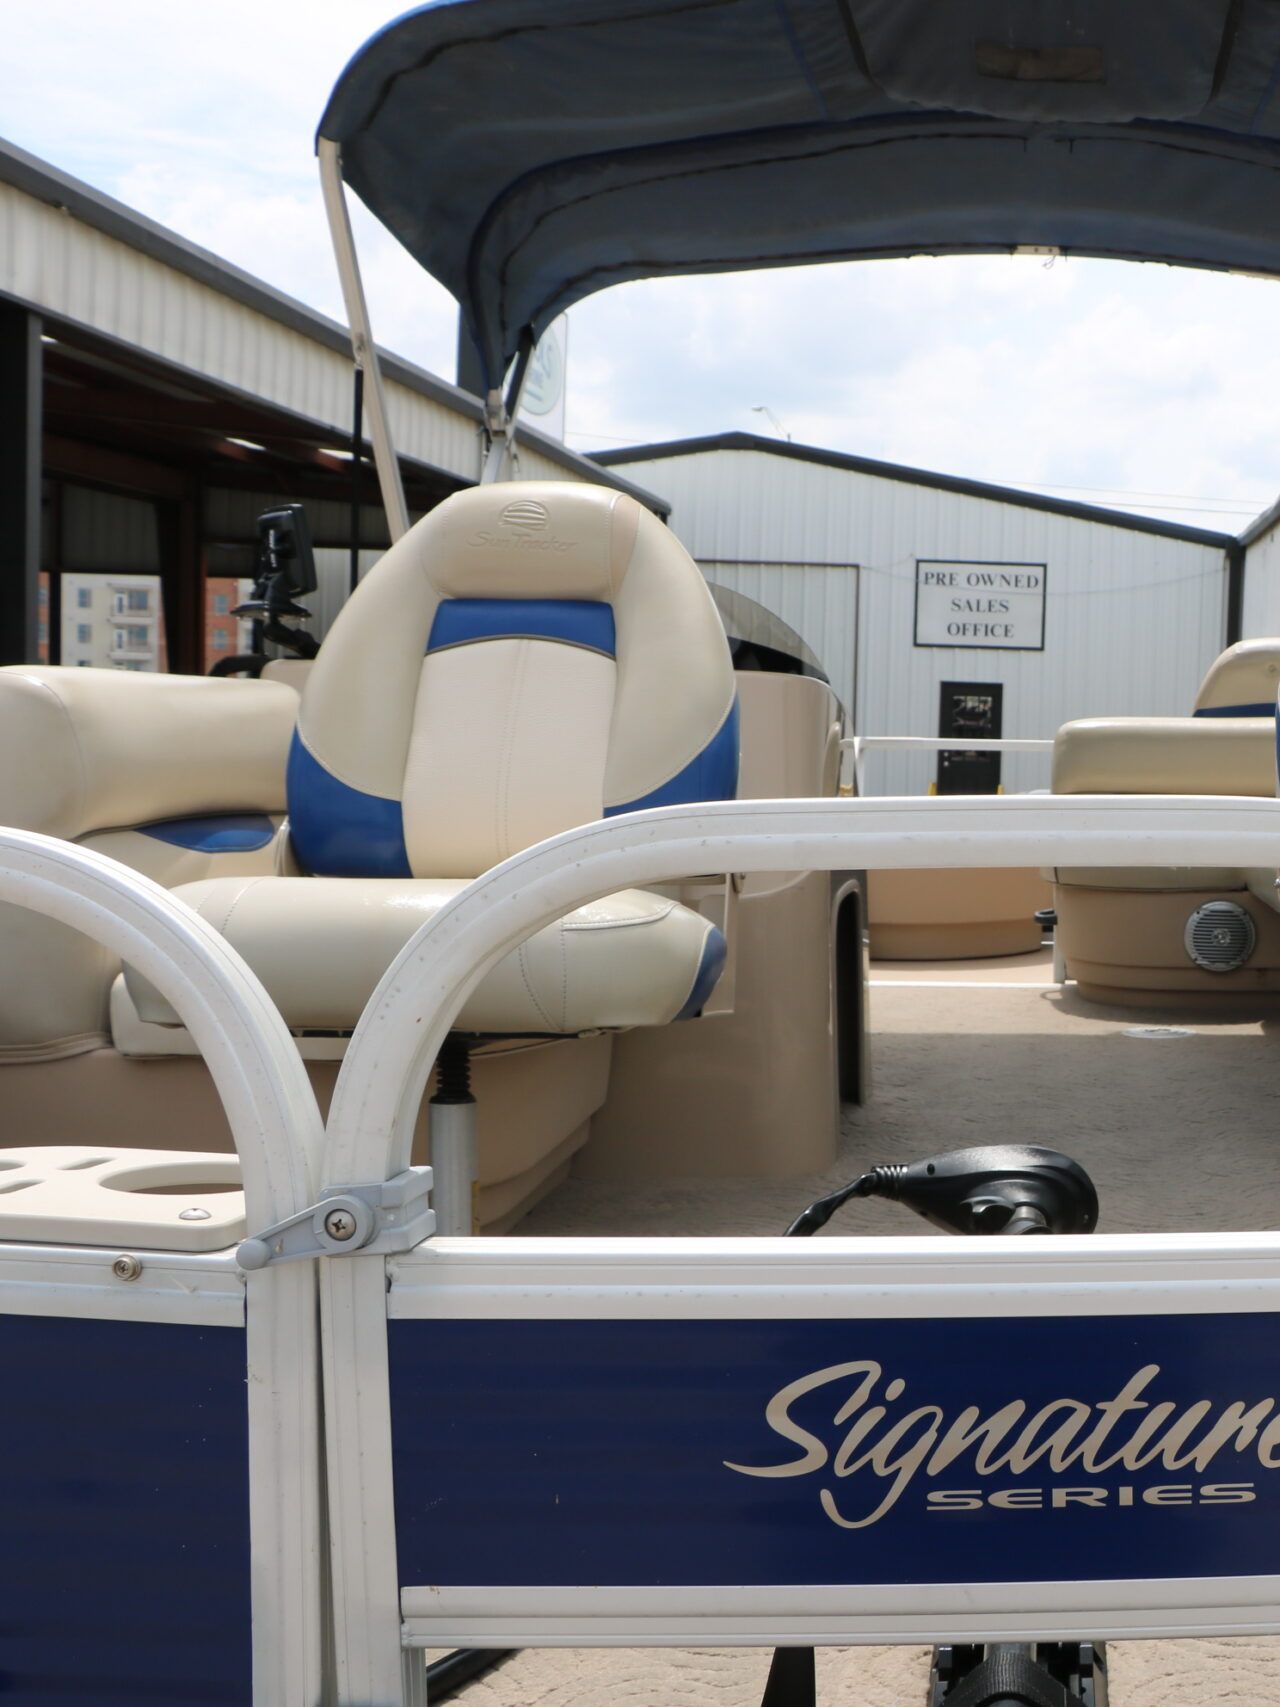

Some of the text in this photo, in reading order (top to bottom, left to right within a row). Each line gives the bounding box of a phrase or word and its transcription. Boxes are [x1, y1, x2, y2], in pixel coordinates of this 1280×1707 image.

[923, 572, 1039, 589] PRE OWNED
[951, 599, 1010, 613] SALES
[947, 622, 1014, 638] OFFICE
[926, 1483, 1257, 1511] SERIES
